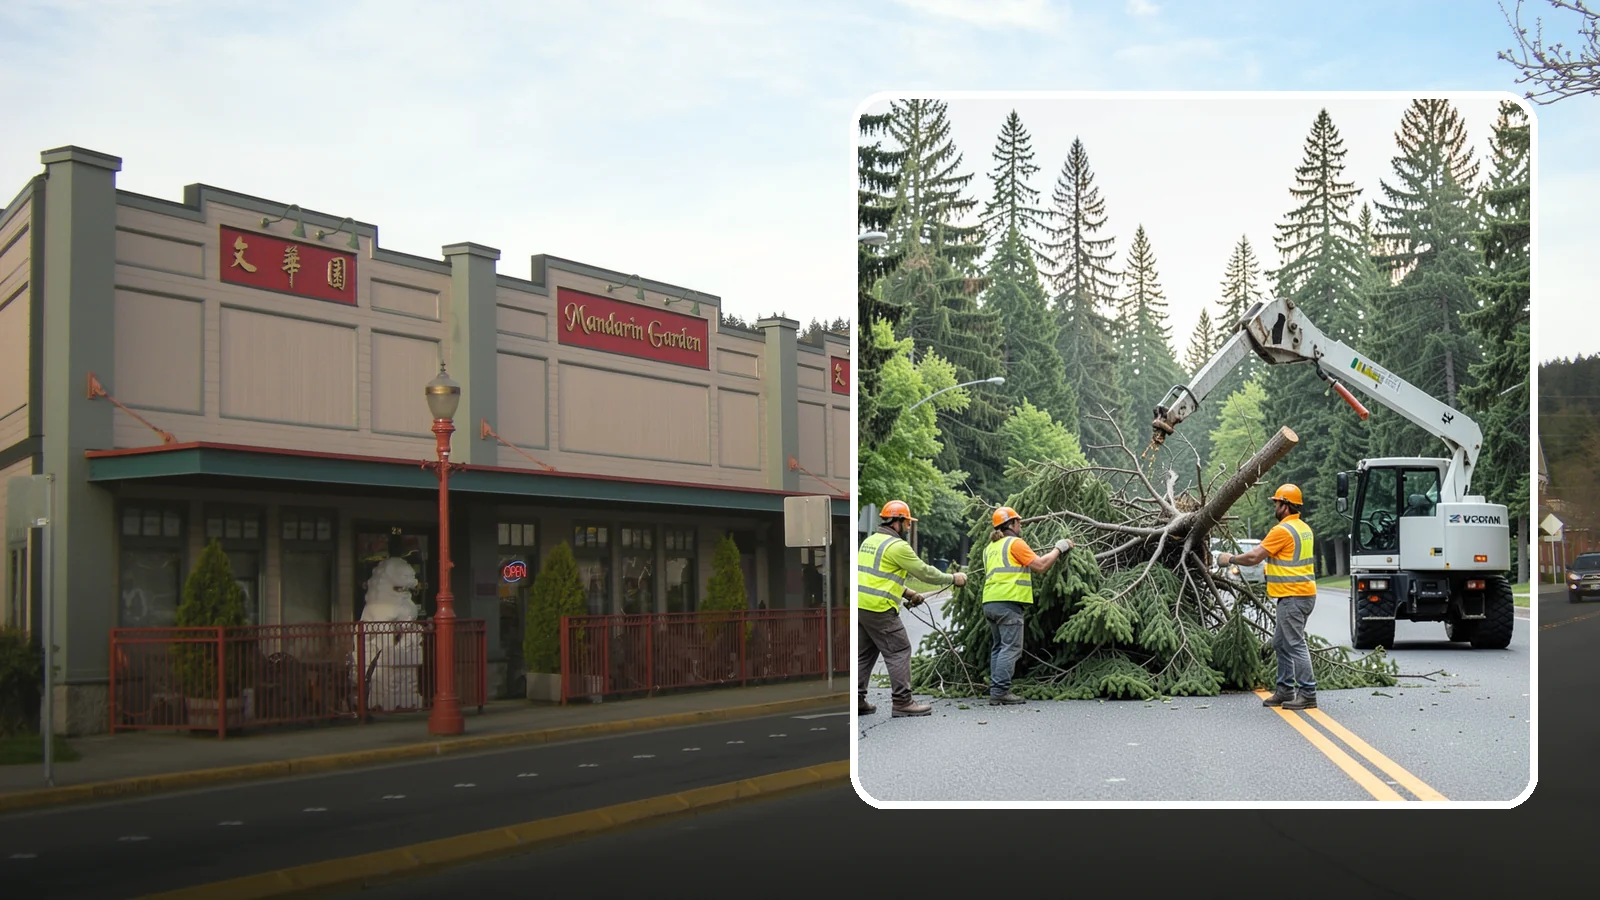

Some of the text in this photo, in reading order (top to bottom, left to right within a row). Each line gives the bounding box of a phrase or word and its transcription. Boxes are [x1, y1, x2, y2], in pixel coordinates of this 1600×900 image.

[230, 235, 346, 291] 文華園
[564, 302, 701, 352] Mandarin Garden
[503, 565, 527, 578] OPEN
